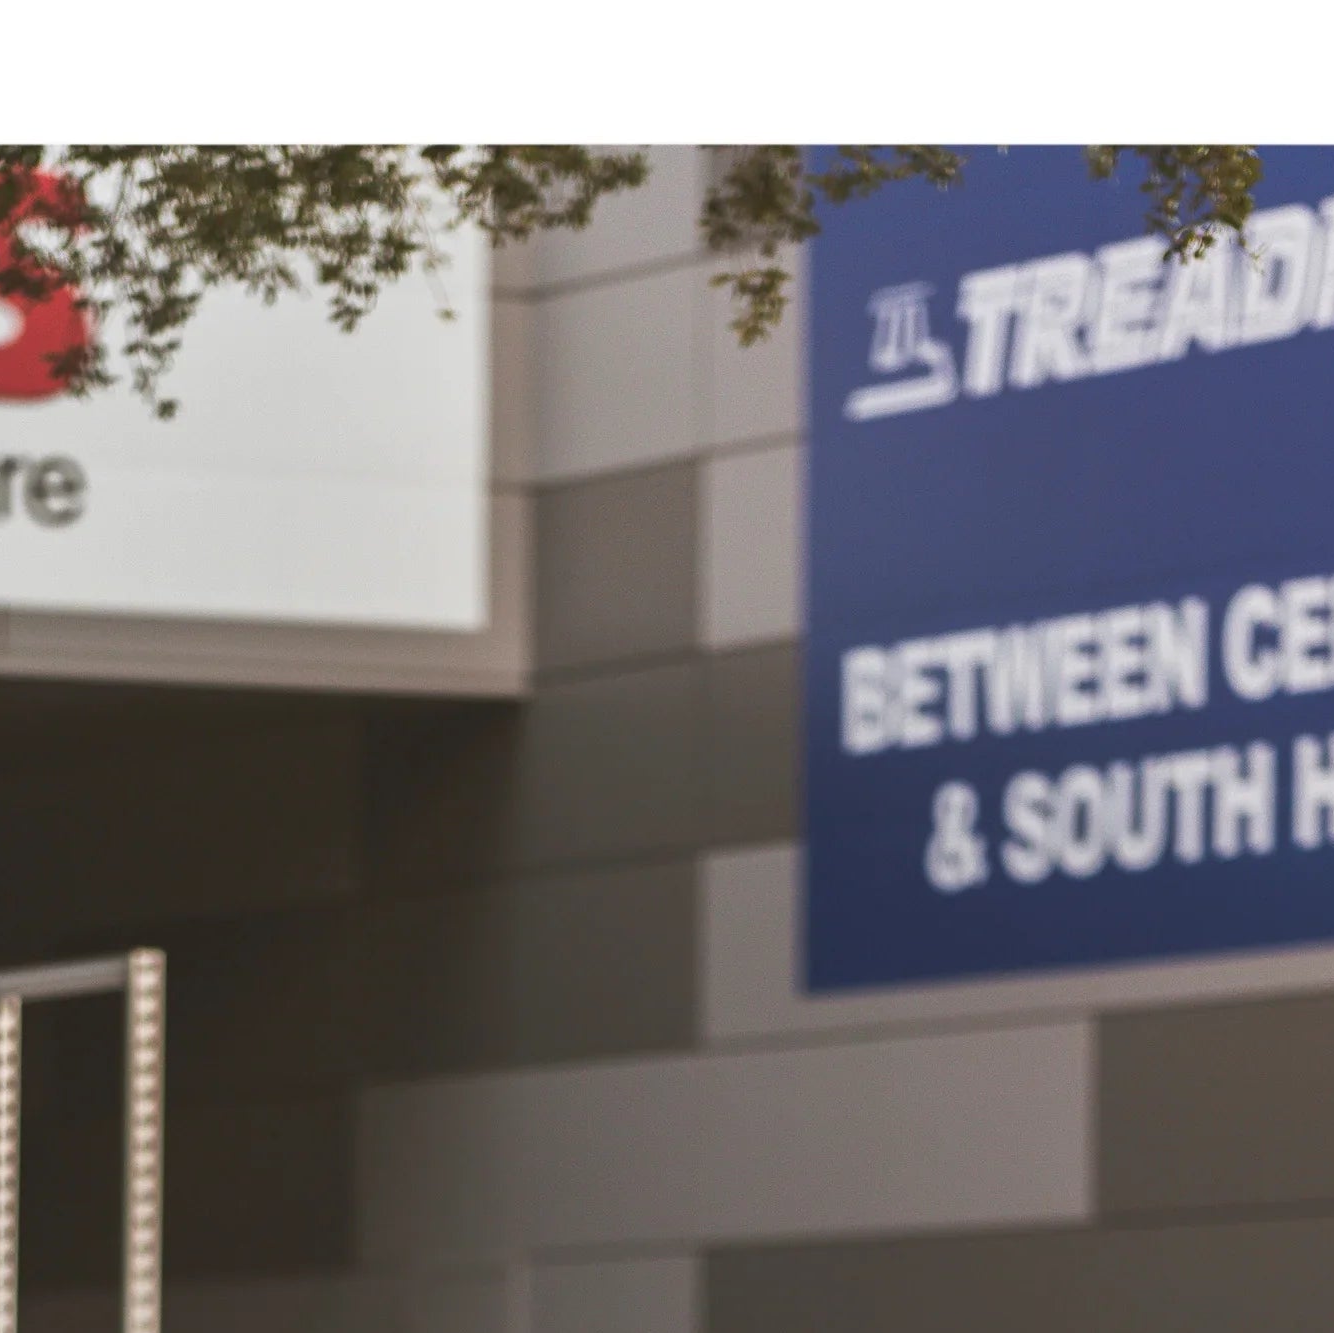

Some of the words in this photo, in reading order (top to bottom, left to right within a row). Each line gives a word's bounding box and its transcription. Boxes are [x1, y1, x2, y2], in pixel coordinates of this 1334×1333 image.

[840, 599, 1209, 757] BETWEEN
[925, 782, 988, 893] &
[1002, 740, 1275, 885] SOUTH
